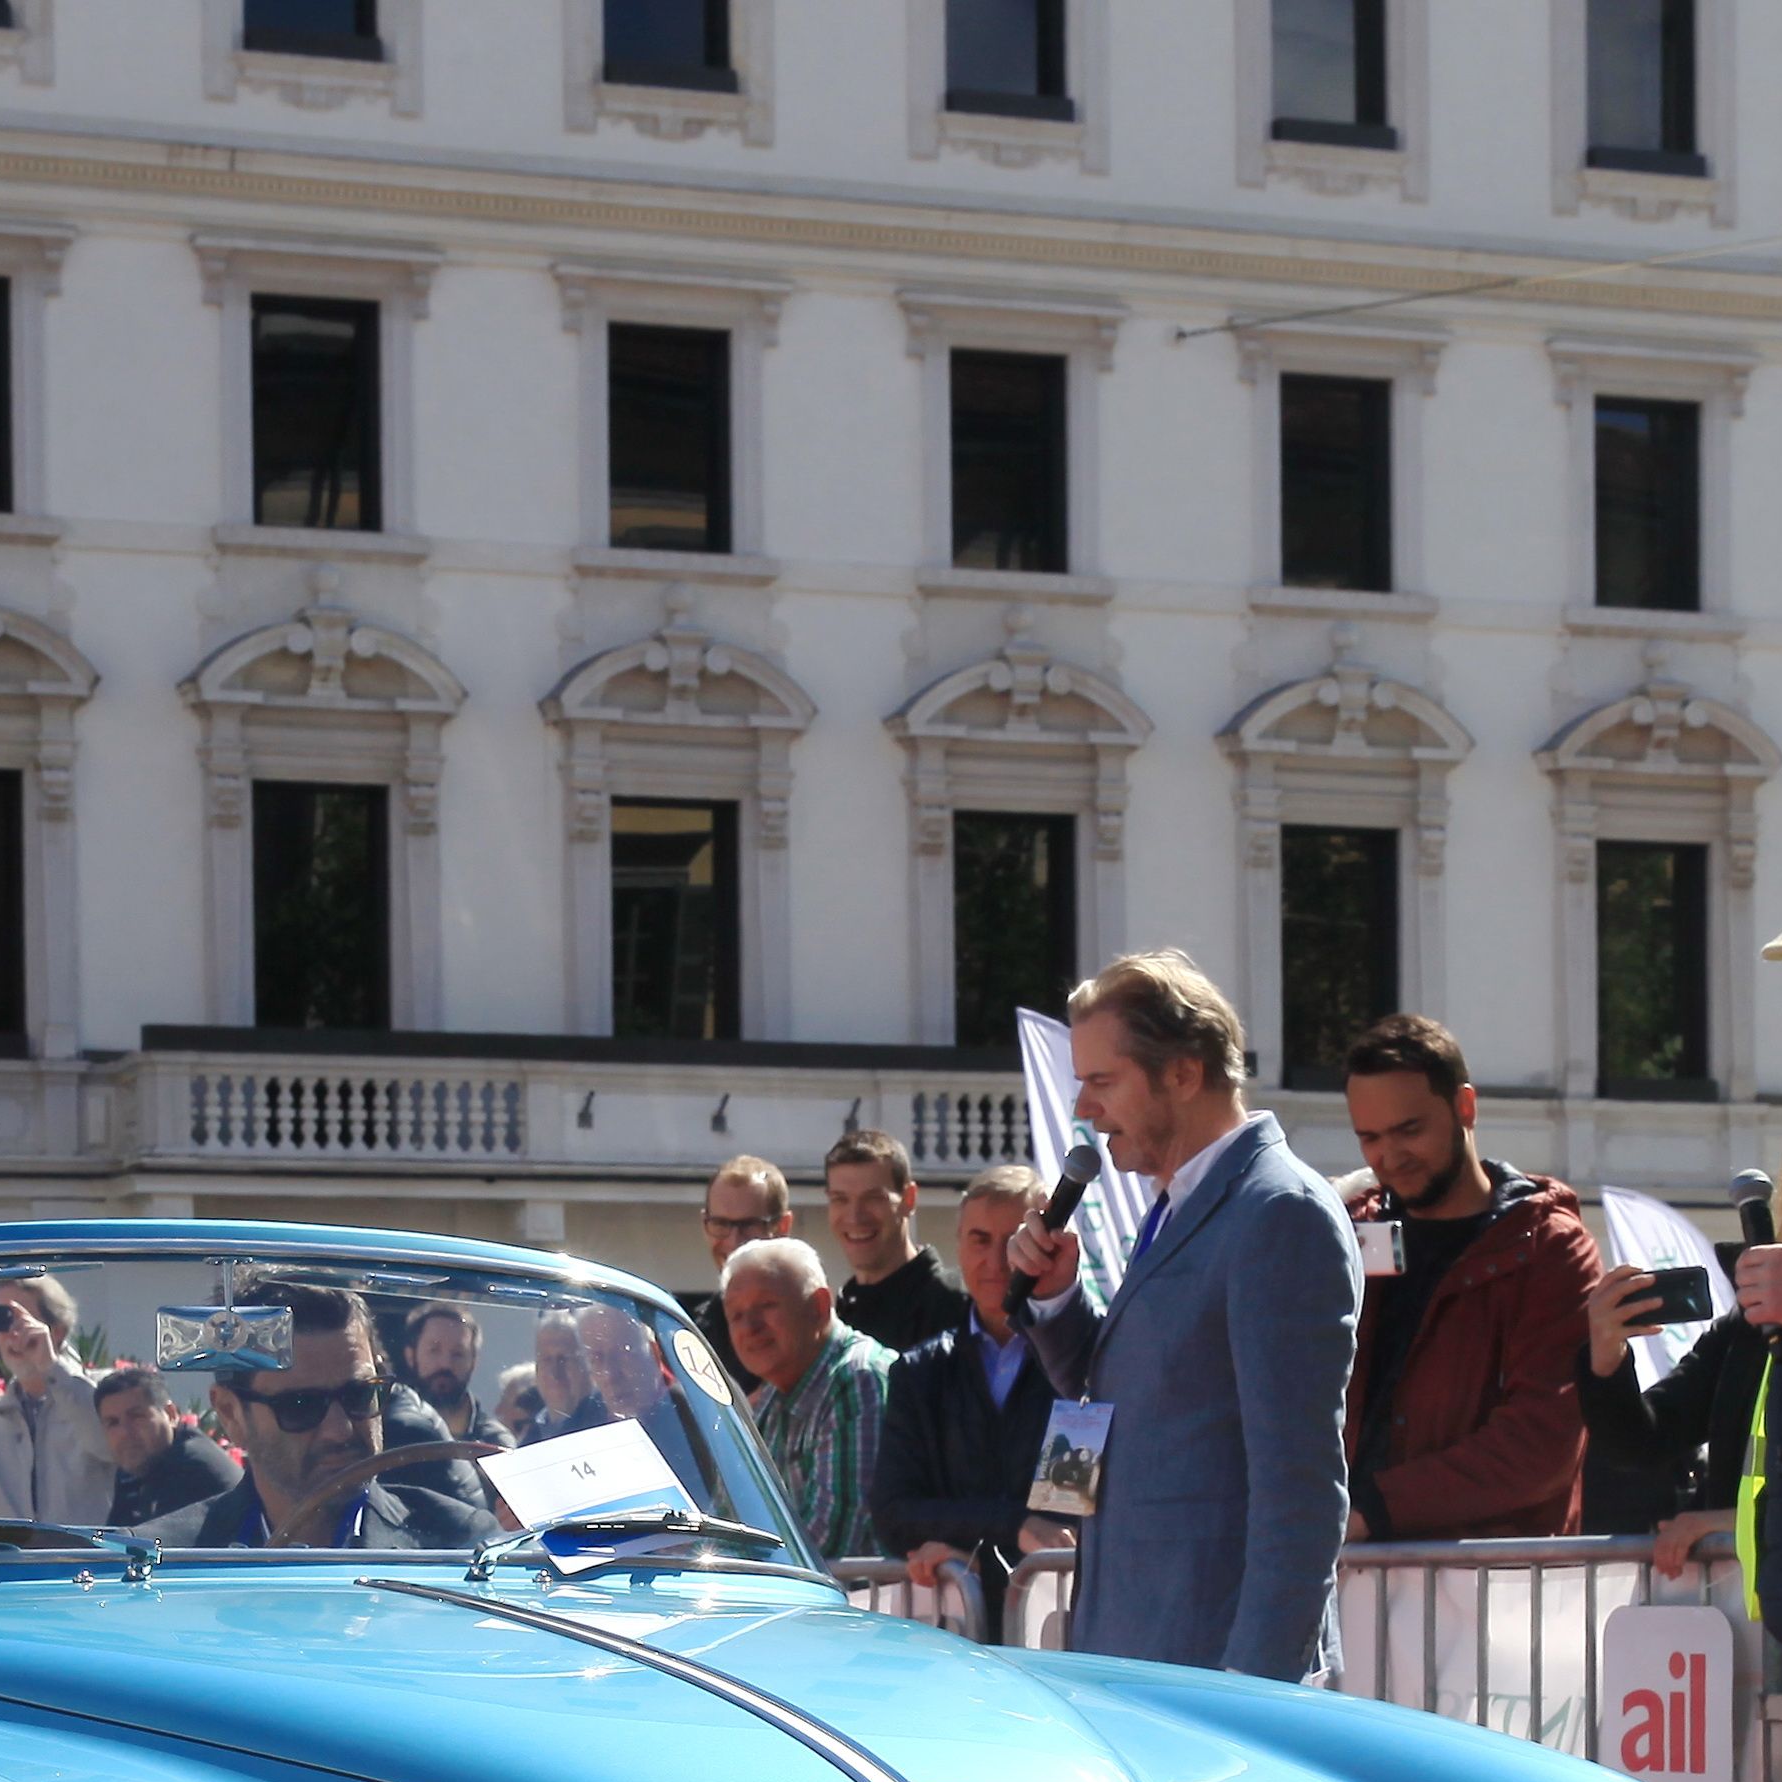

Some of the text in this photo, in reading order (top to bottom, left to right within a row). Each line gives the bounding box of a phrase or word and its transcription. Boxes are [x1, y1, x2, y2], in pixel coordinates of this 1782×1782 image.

[682, 1345, 723, 1394] 14
[570, 1461, 597, 1480] 14
[1621, 1651, 1706, 1774] ail
